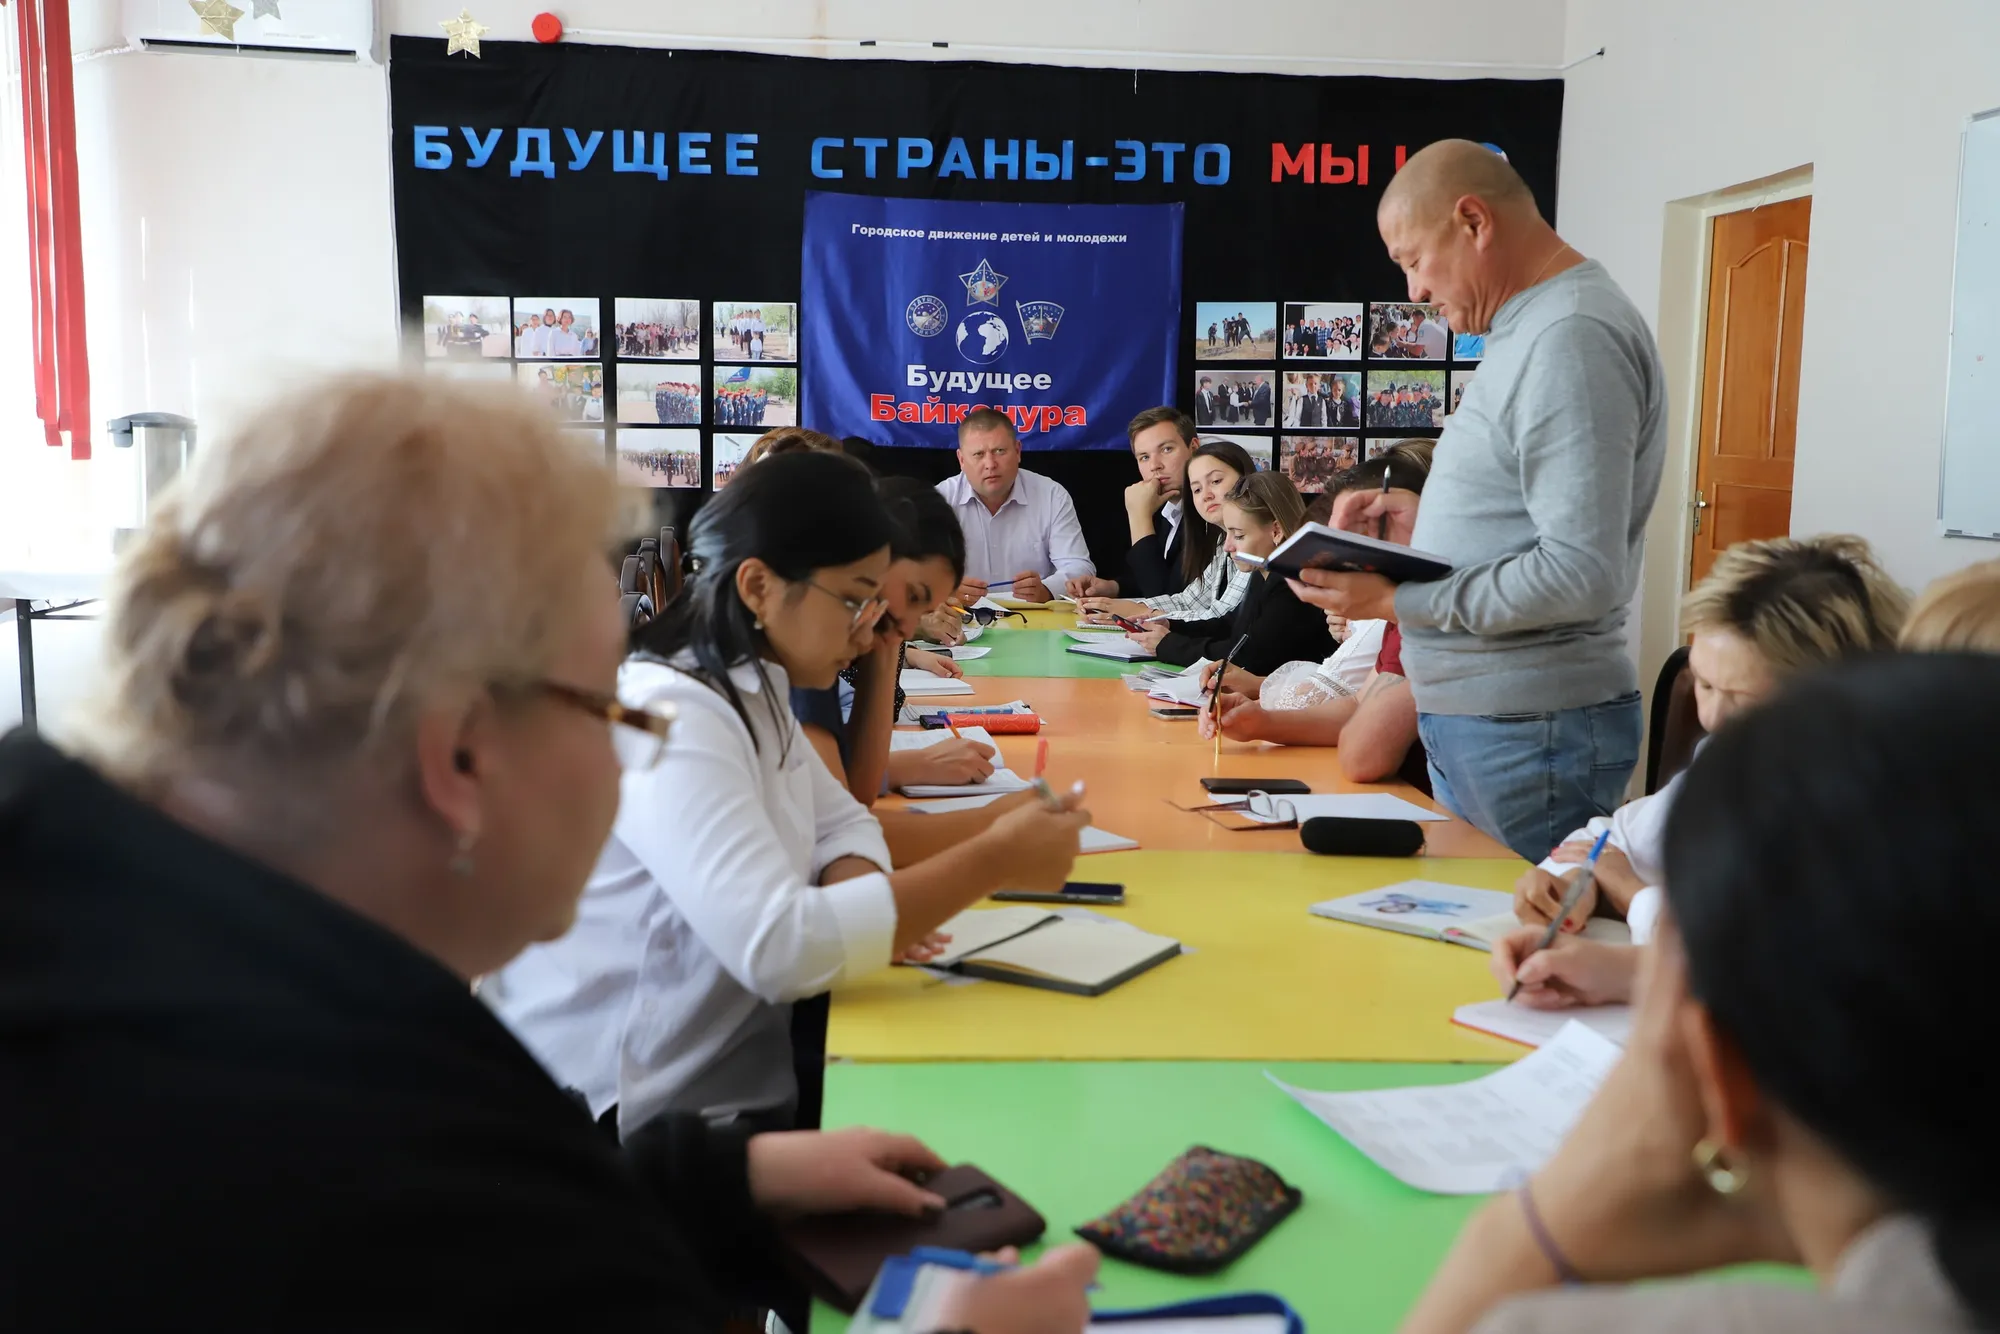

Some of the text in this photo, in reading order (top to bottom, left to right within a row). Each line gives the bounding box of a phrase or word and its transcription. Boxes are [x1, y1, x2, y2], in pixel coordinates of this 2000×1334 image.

[413, 125, 759, 181] БУДУЩЕЕ
[1270, 142, 1369, 186] МЫ
[851, 223, 1127, 244] Городское движение детей и молодежи
[906, 364, 1052, 394] Будущее
